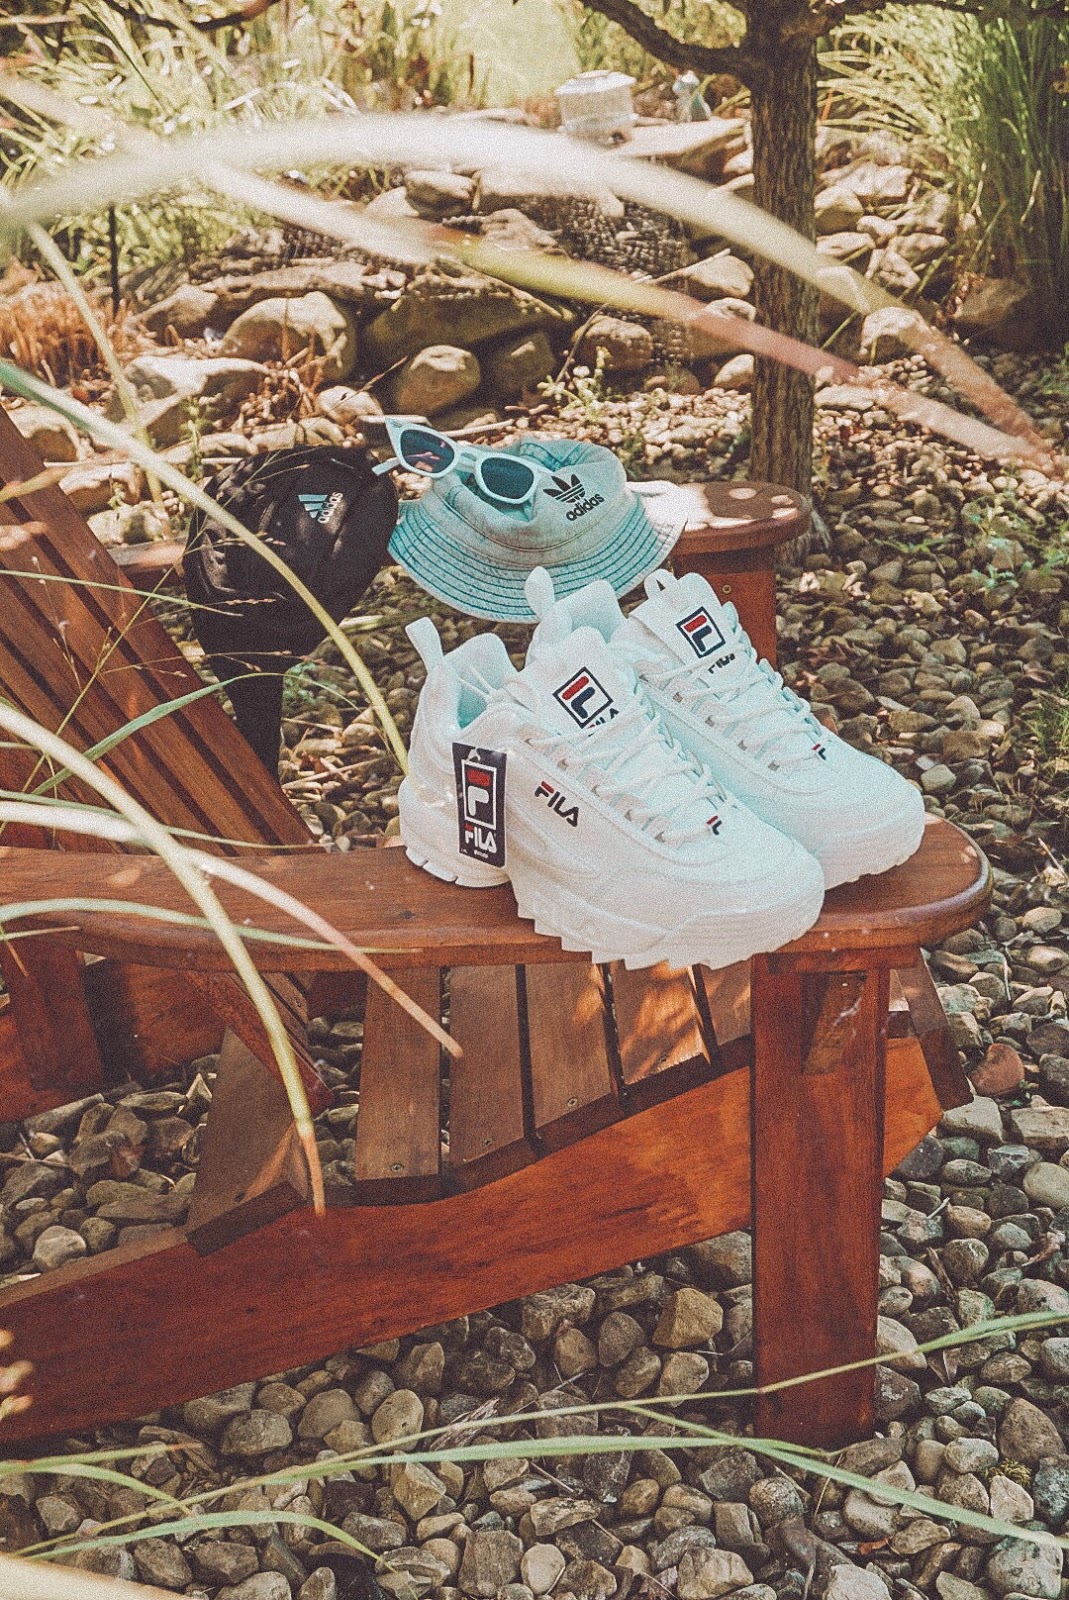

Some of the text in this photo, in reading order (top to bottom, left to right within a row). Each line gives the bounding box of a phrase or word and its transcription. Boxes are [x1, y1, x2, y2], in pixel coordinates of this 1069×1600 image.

[566, 493, 605, 521] adidas
[534, 780, 579, 828] FILA
[463, 822, 497, 854] FILA
